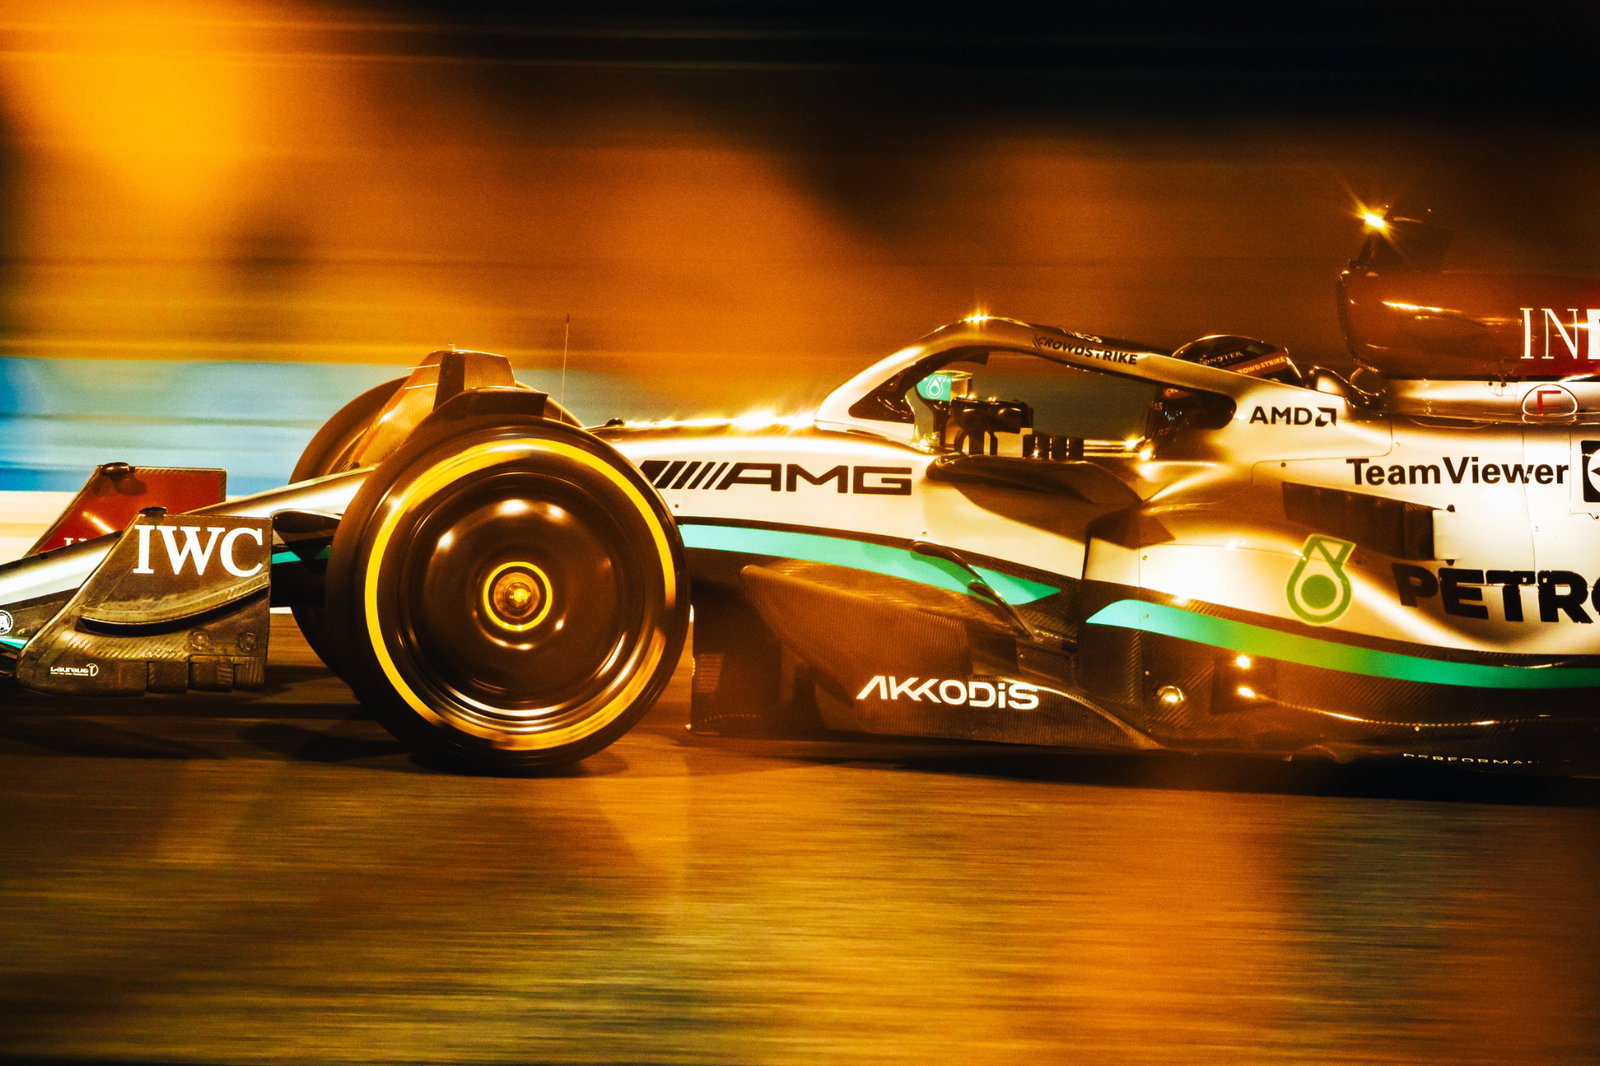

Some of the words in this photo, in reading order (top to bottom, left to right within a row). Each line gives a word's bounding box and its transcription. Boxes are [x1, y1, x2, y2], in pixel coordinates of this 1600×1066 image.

[1520, 307, 1600, 360] IN
[1039, 336, 1139, 365] CROWDSTRIKE
[1236, 356, 1287, 375] ROWDSTRIKE
[1249, 405, 1314, 426] AMD
[714, 461, 913, 497] AMG
[1346, 456, 1569, 486] TeamViewer
[132, 524, 263, 578] IWC
